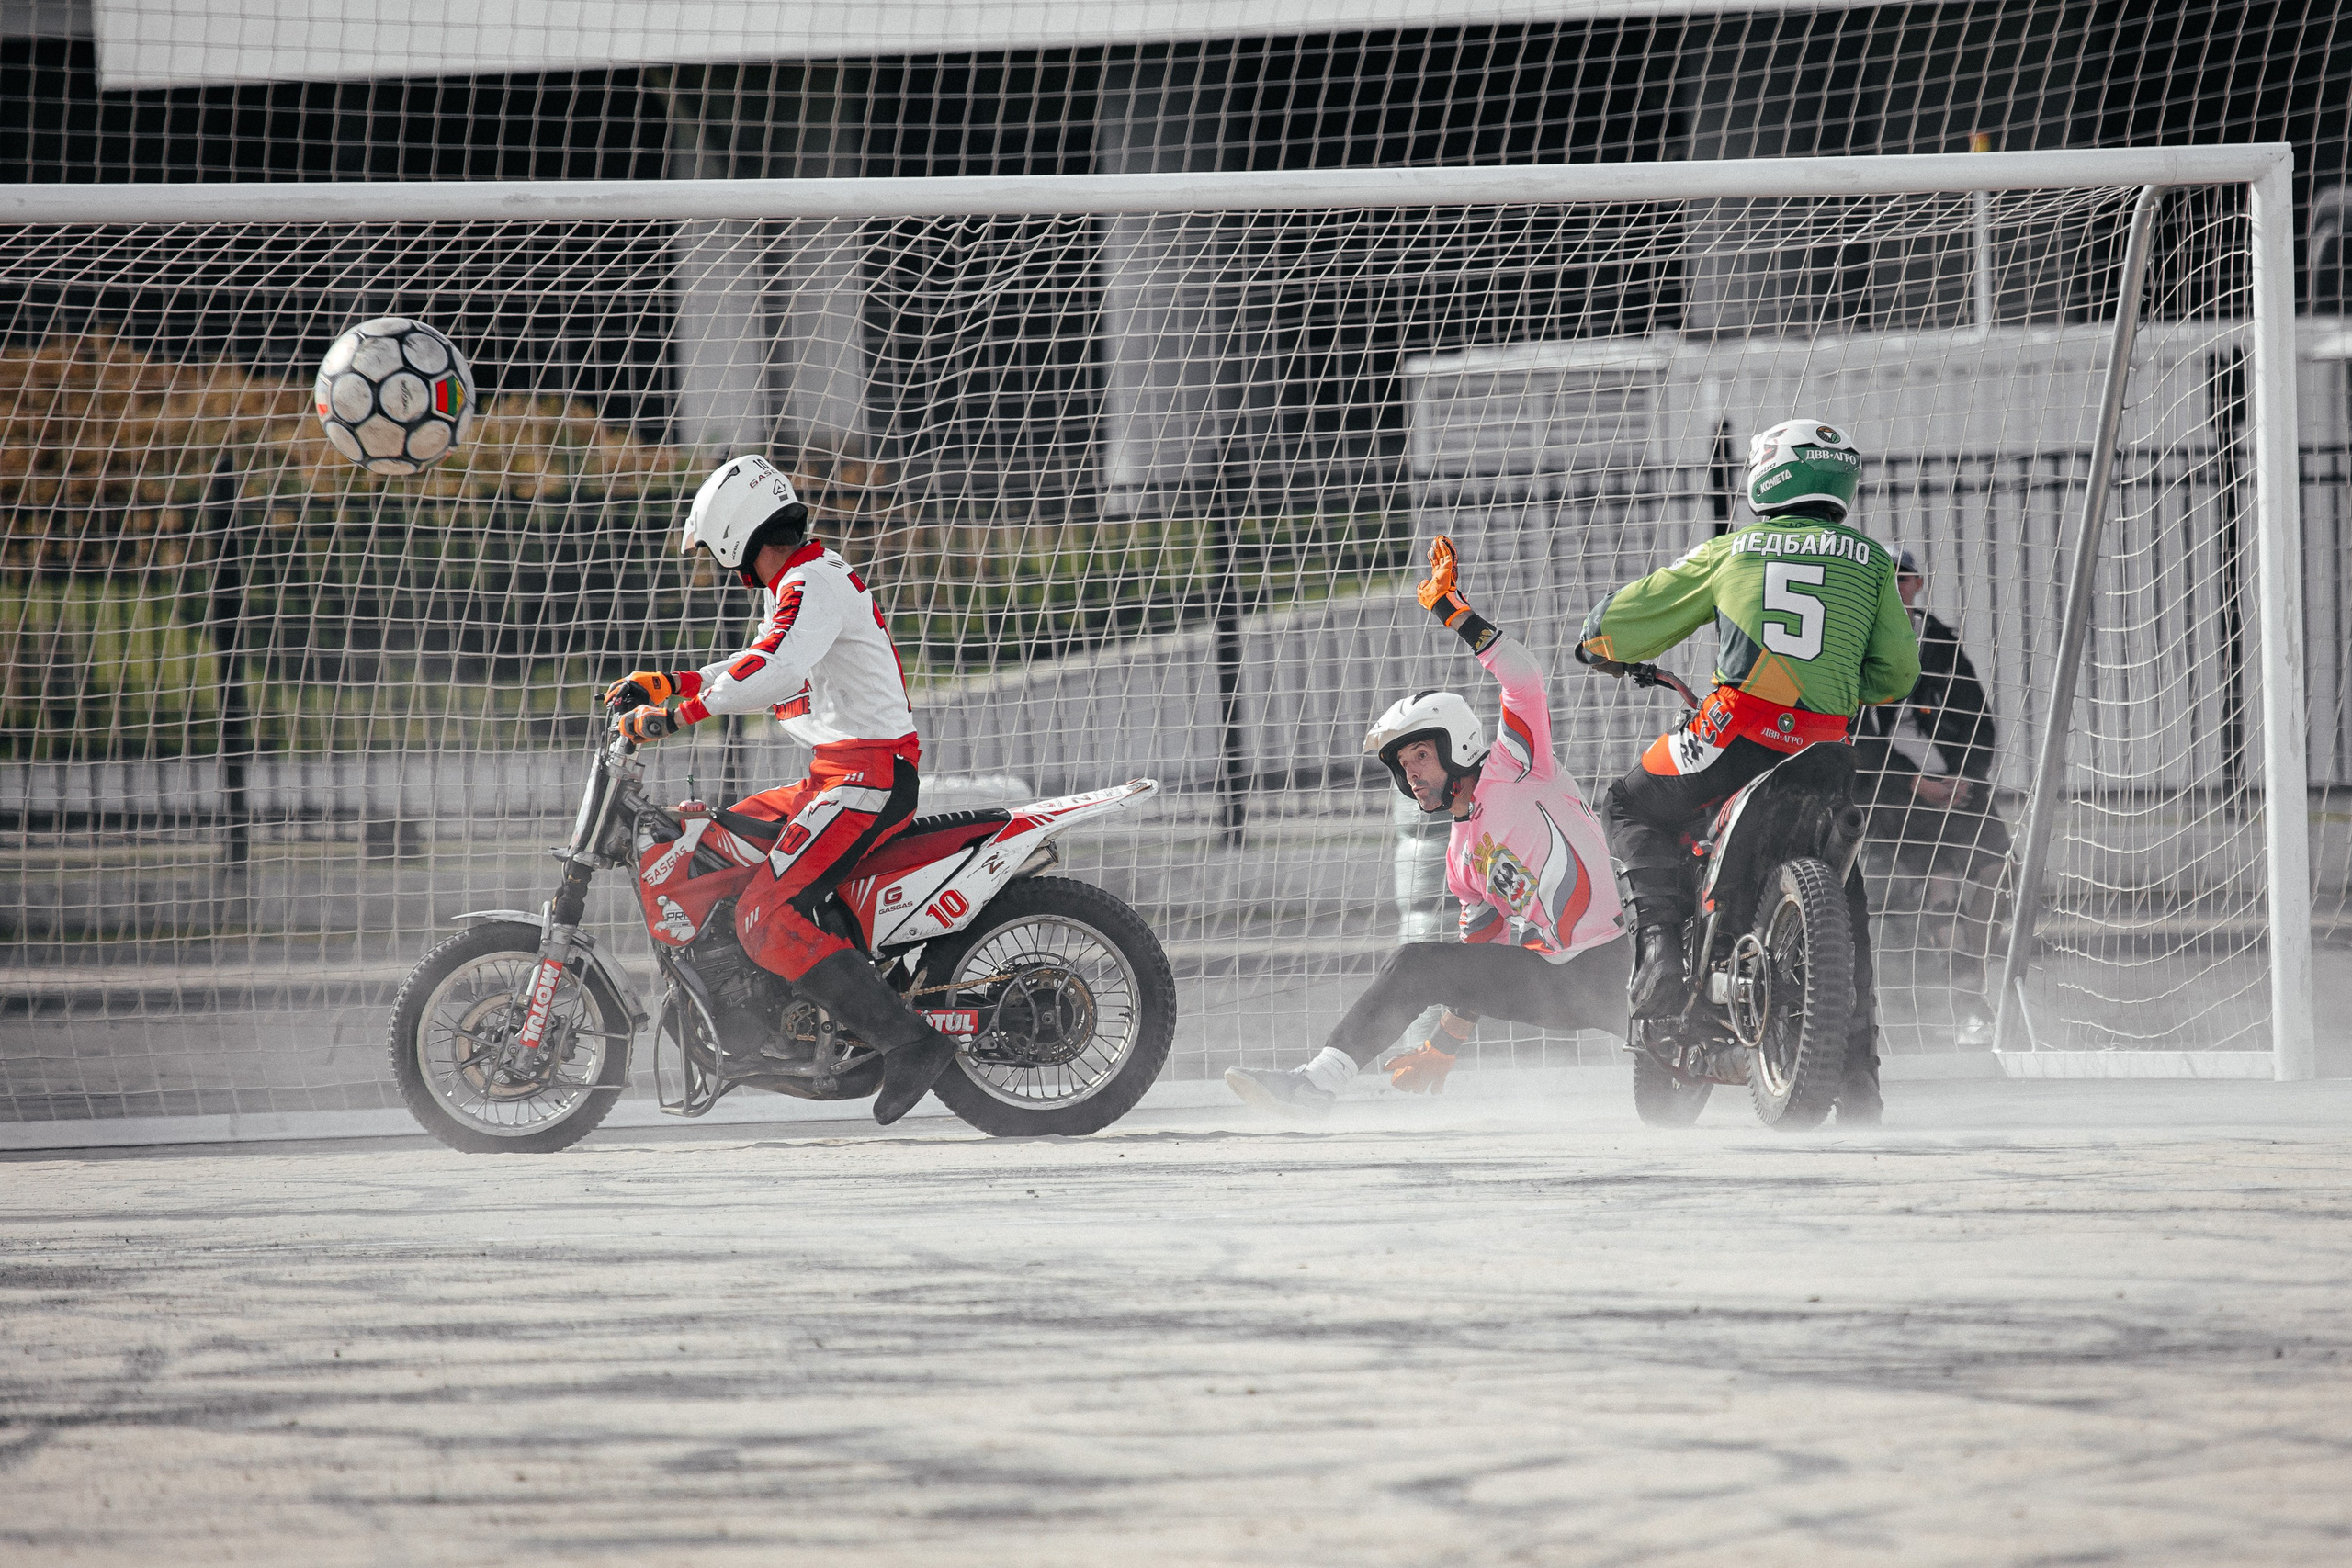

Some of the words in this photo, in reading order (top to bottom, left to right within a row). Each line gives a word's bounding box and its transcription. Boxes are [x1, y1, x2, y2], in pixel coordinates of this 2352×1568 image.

[1731, 530, 1871, 565] НЕДБАЙЛО
[1762, 560, 1827, 662] 5
[644, 845, 689, 886] GASGAS
[878, 901, 914, 915] GASGAS
[925, 888, 970, 930] 10
[522, 963, 560, 1043] MOTUL
